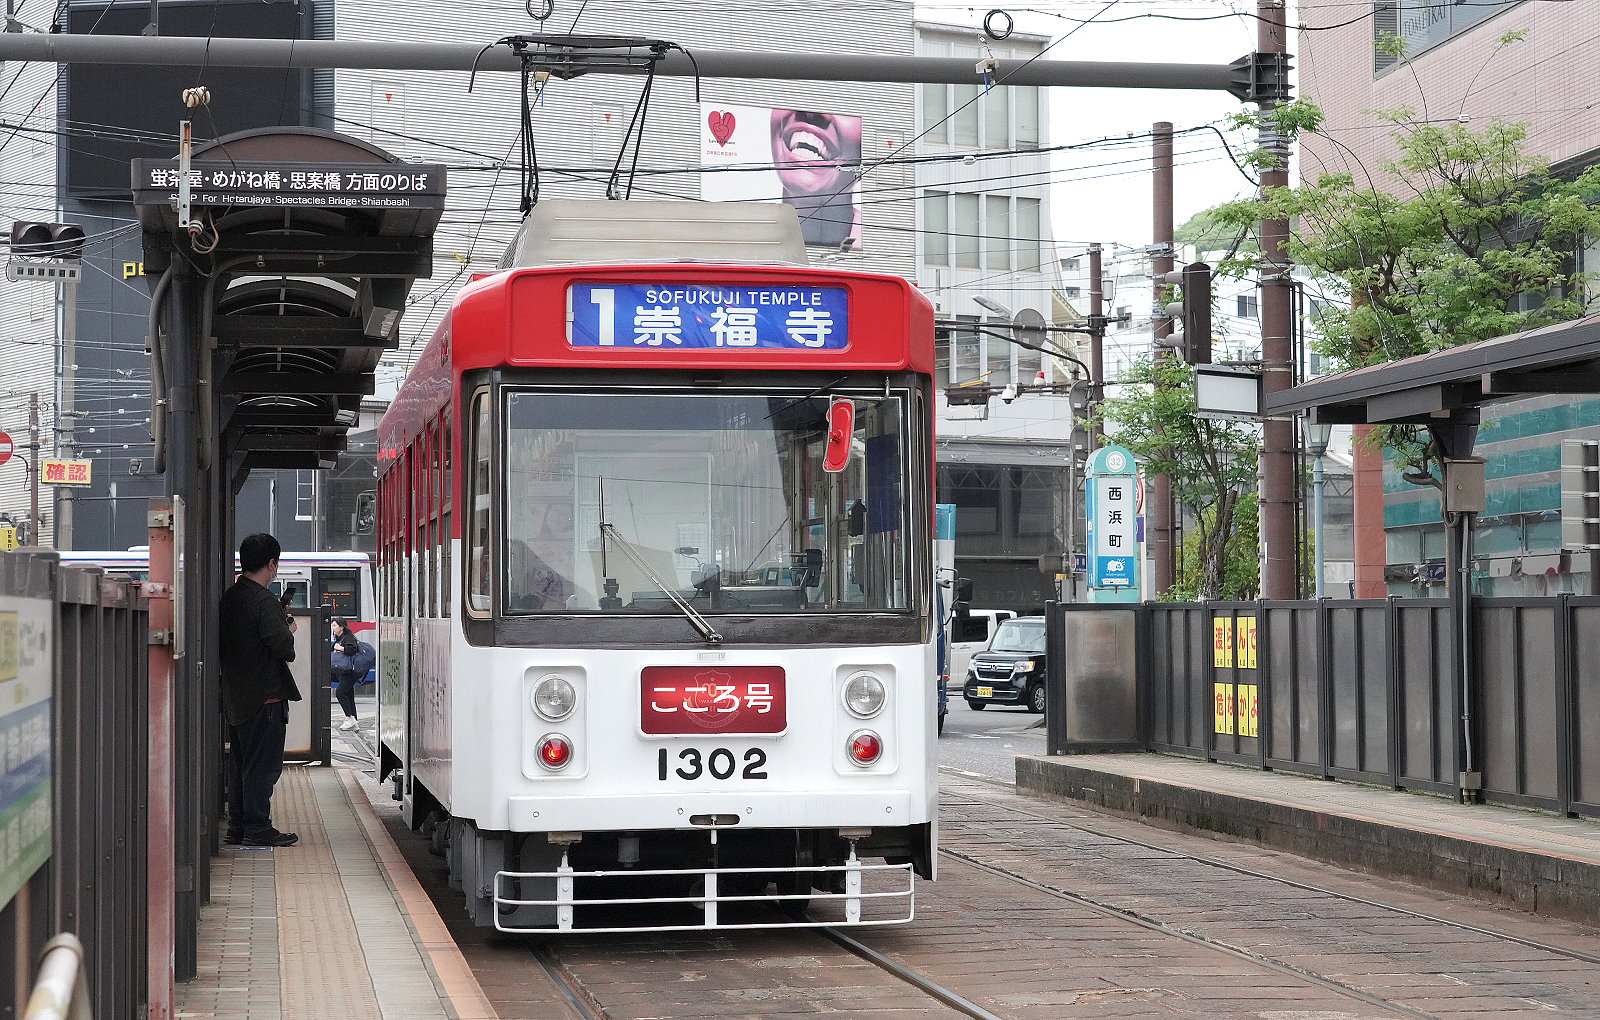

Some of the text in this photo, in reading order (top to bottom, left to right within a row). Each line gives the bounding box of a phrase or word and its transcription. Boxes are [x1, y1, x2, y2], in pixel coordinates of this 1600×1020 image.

[345, 172, 428, 191] 方面のりば
[202, 194, 218, 203] For
[645, 290, 822, 306] SOFUKUJI TEMPLE
[590, 288, 615, 346] 1
[633, 305, 834, 348] 崇福寺
[46, 463, 87, 481] 確認
[1110, 457, 1122, 466] 32
[1108, 486, 1123, 548] 西浜町
[651, 683, 774, 714] こころ号
[658, 747, 768, 781] 1302
